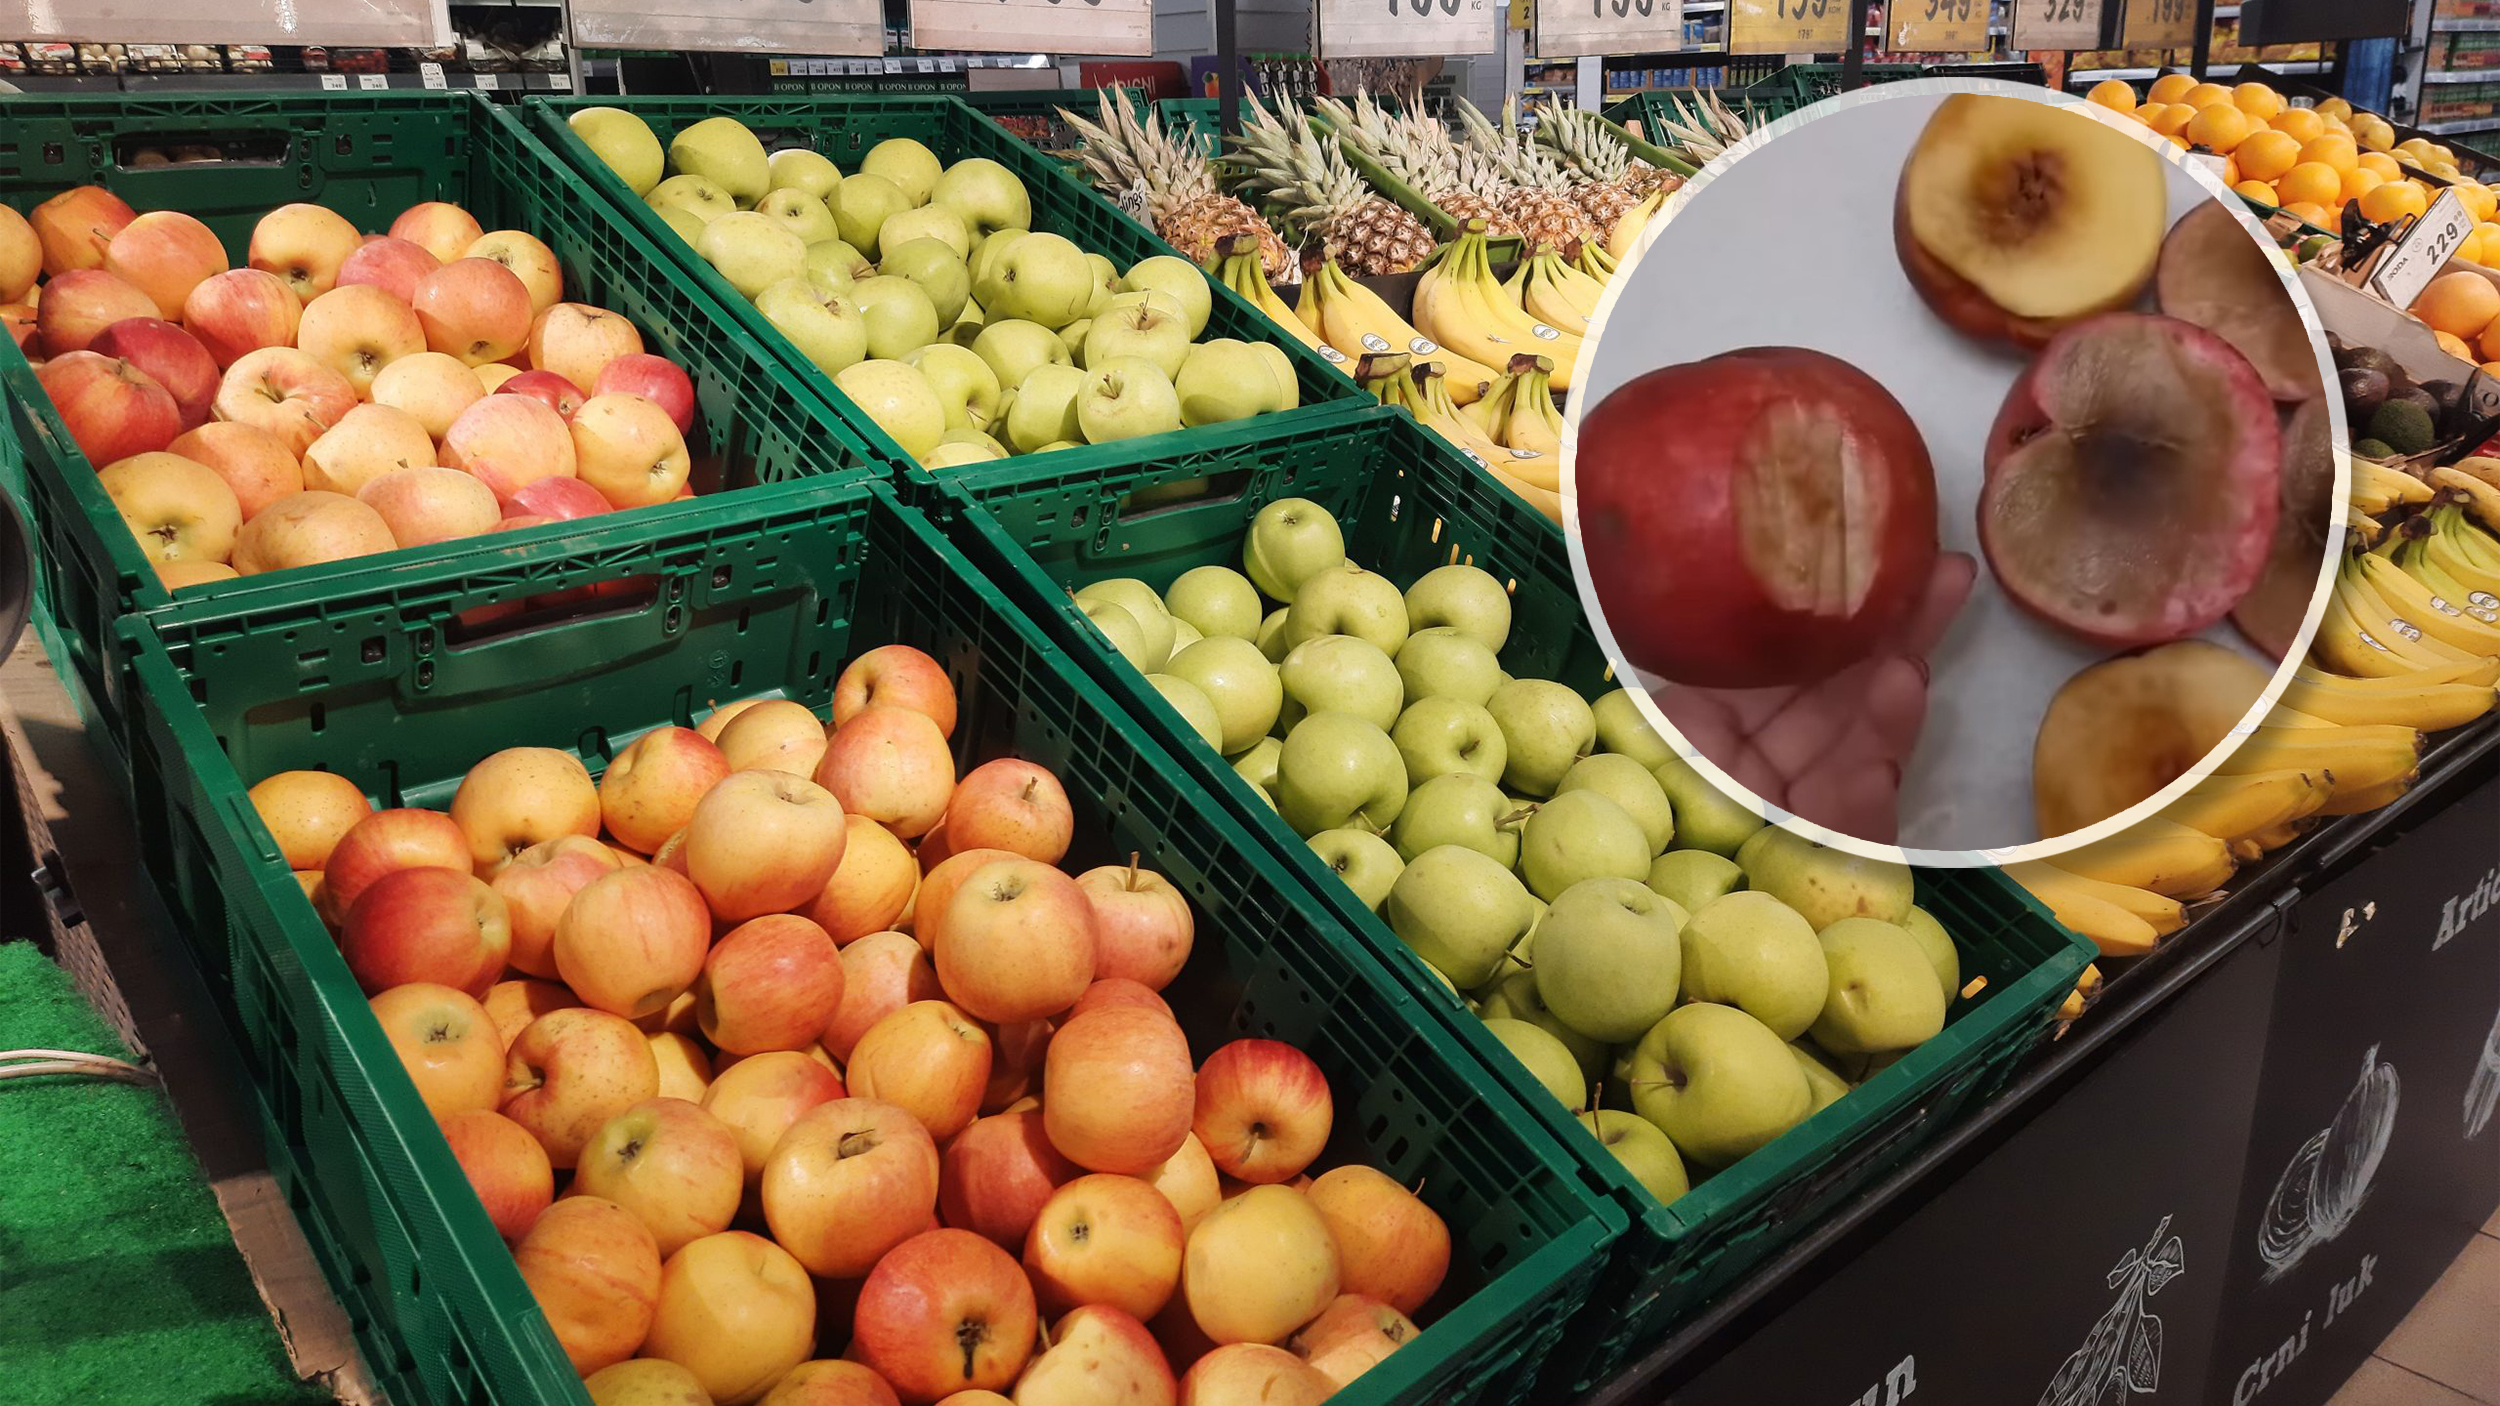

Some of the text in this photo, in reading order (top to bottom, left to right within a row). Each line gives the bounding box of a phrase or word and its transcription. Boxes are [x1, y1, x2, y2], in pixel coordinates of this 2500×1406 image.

[1471, 1, 1482, 11] KG
[1661, 1, 1671, 11] KG
[774, 82, 805, 92] BOPON
[810, 82, 842, 91] BOPON
[845, 82, 873, 91] BOPON
[879, 83, 907, 91] BOPON
[907, 83, 936, 91] BOPON
[2427, 222, 2458, 265] 229
[2233, 1254, 2379, 1406] Crni luk
